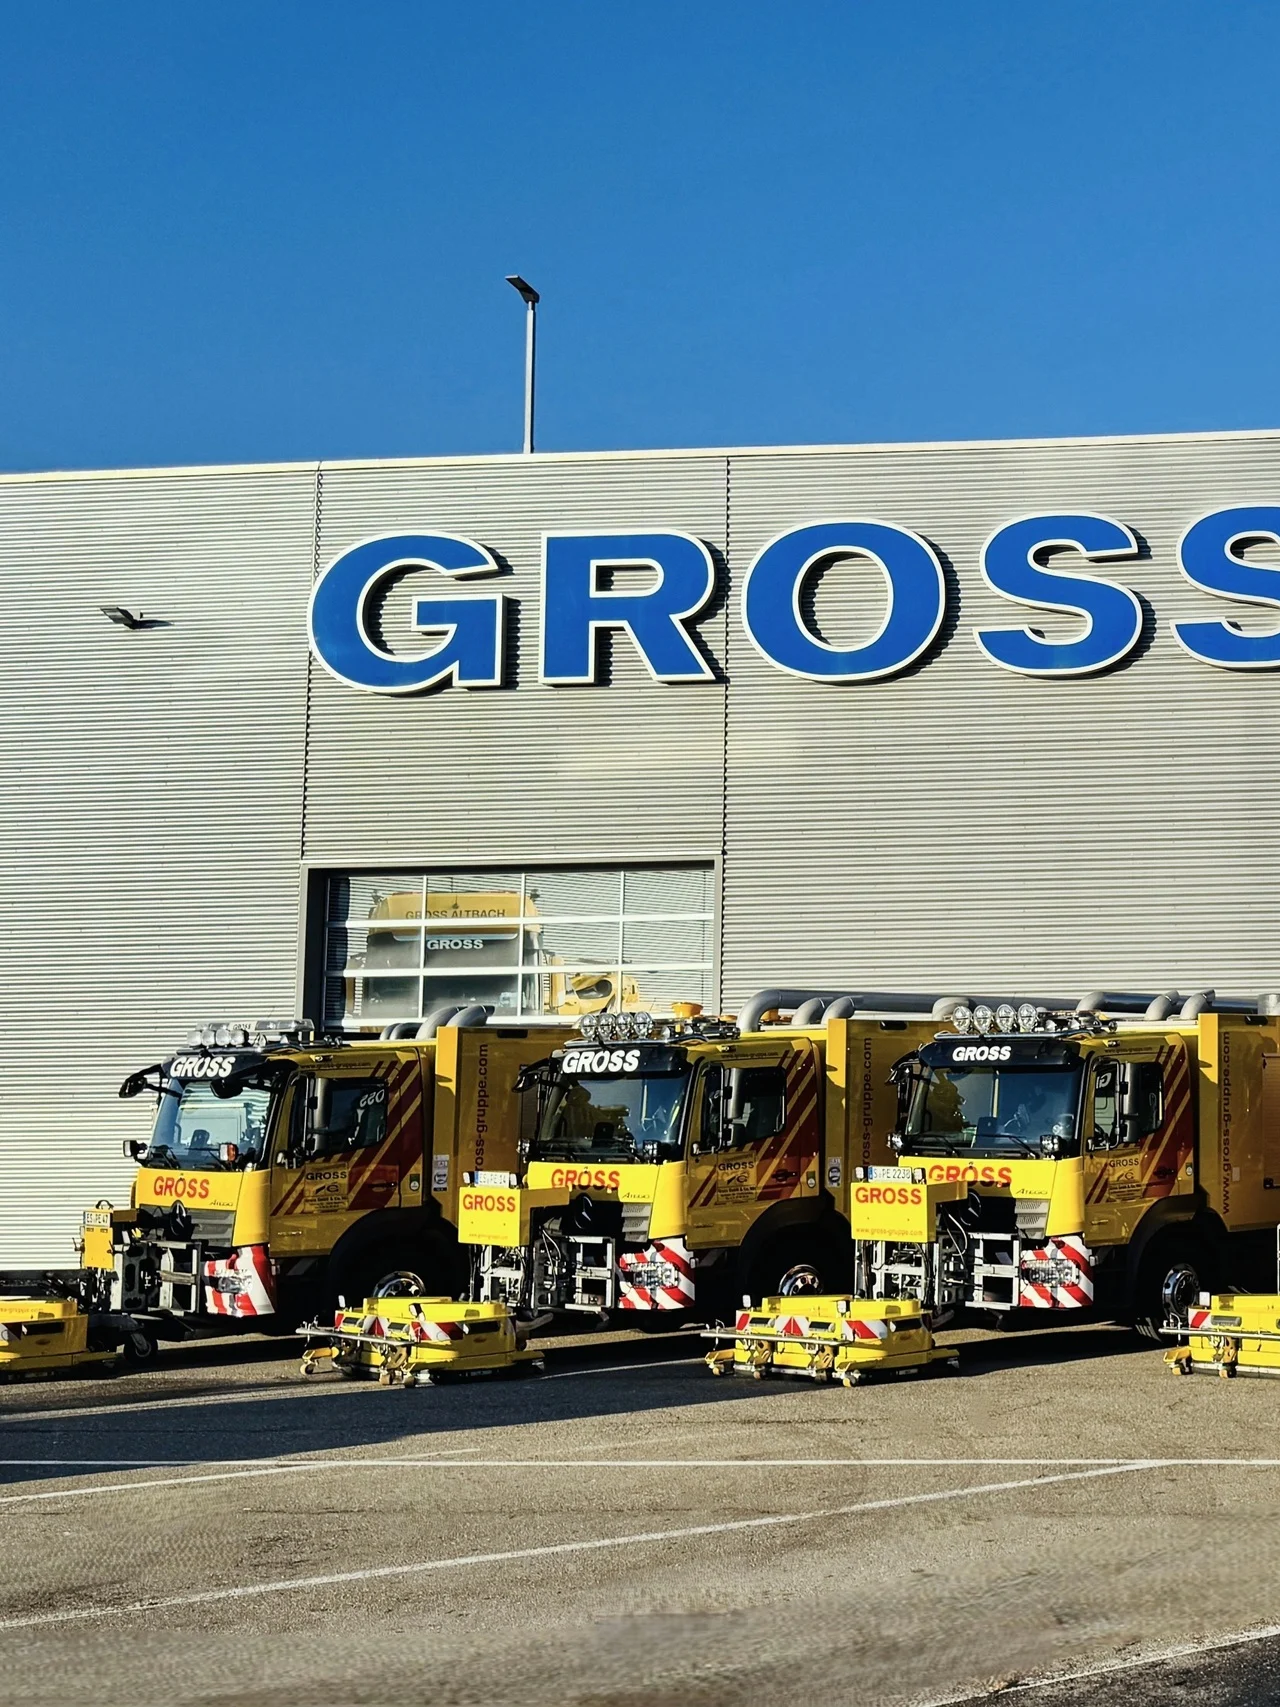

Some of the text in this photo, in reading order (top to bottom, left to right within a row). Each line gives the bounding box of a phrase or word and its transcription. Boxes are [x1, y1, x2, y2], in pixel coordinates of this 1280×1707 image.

[427, 939, 484, 950] GROSS
[562, 1050, 640, 1074] GROSS
[952, 1046, 1011, 1062] GROSS
[170, 1056, 236, 1079] GROSS
[1222, 1031, 1233, 1215] www.gross-gruppe.com
[718, 1161, 754, 1171] GROSS
[1109, 1158, 1139, 1168] GROSS
[306, 1171, 347, 1180] GROSS
[551, 1168, 620, 1191] GROSS
[929, 1164, 1013, 1188] GROSS
[153, 1175, 210, 1199] GROSS
[855, 1187, 922, 1205] GROSS
[462, 1193, 516, 1212] GROSS
